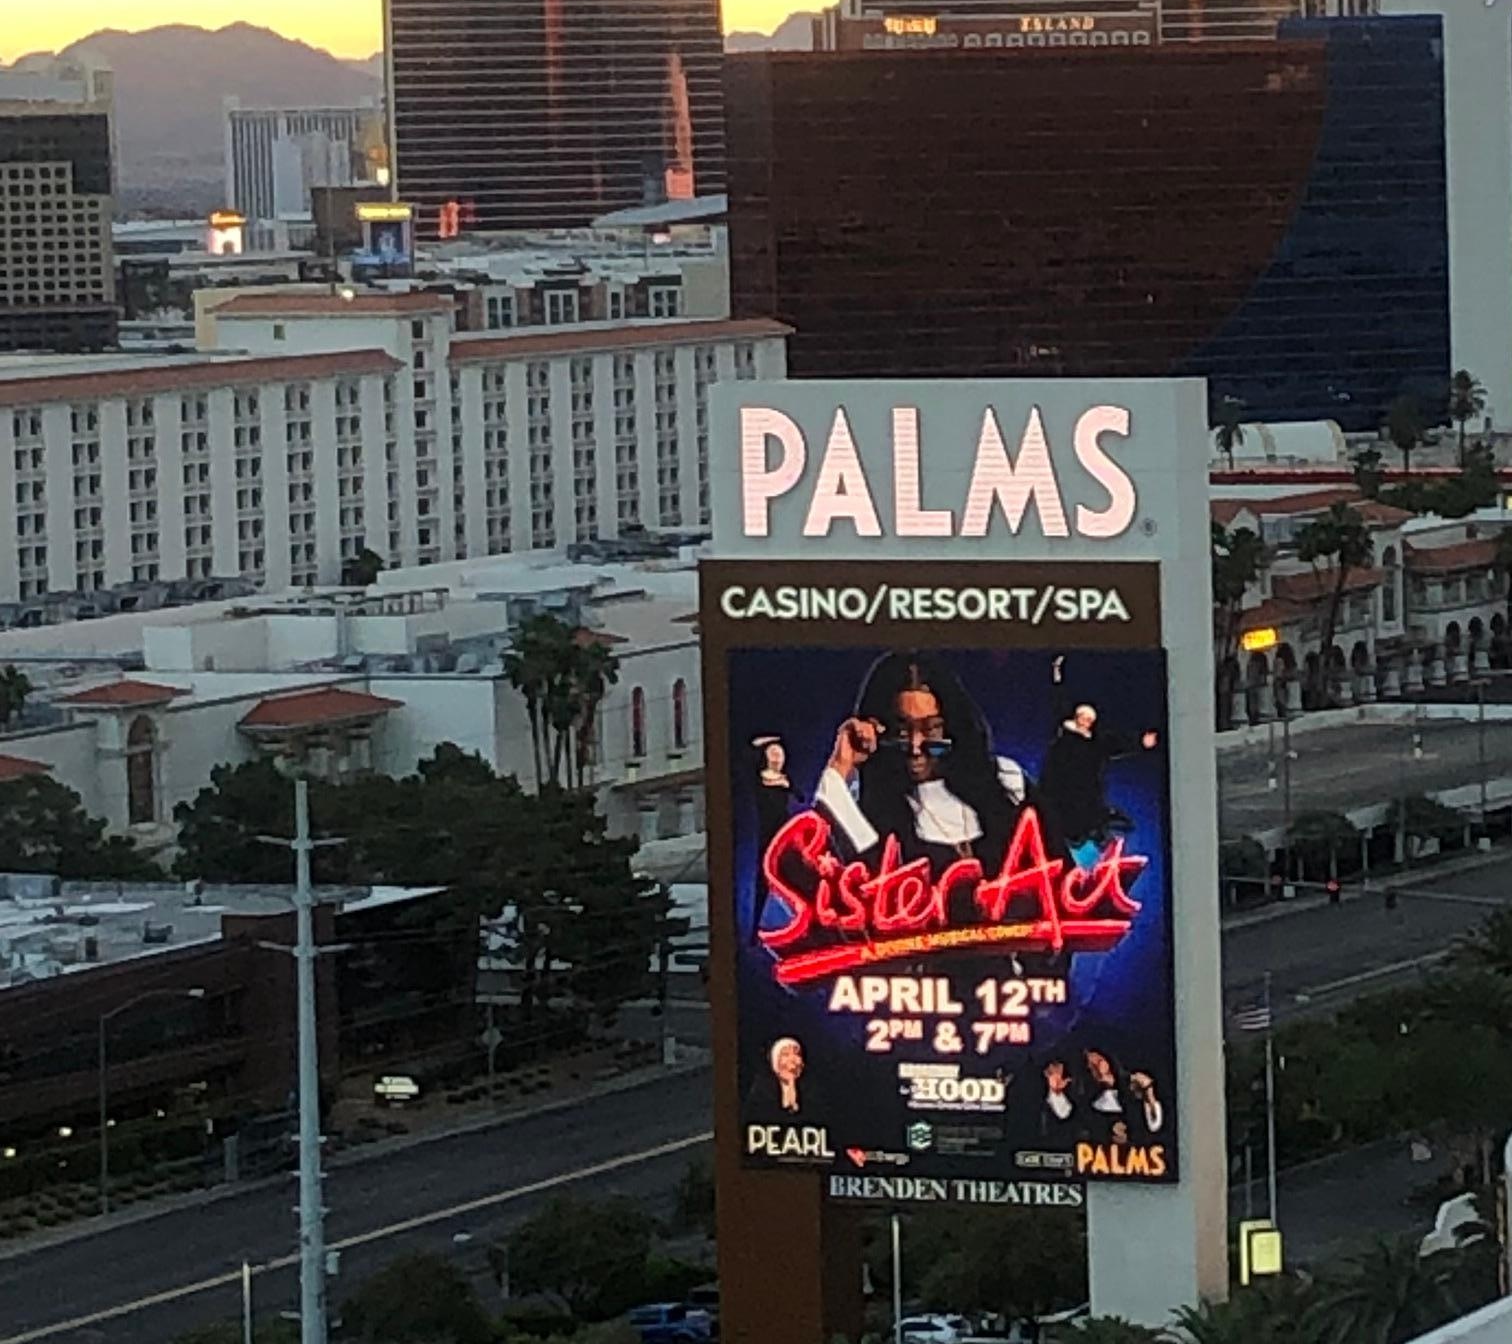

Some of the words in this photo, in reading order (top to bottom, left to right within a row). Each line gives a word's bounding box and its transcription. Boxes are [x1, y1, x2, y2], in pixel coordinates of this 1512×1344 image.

[740, 404, 1137, 538] PALMS
[720, 583, 1131, 624] CASINO/RESORT/SPA
[757, 809, 983, 940] Sister
[976, 805, 1148, 949] Act
[828, 975, 963, 1014] APRIL
[975, 978, 1066, 1017] 12TH
[865, 1018, 923, 1053] 2PM
[933, 1020, 964, 1053] &
[971, 1021, 1030, 1055] 7PM
[911, 1077, 1005, 1102] HOOD
[748, 1124, 836, 1157] PEARL
[1076, 1141, 1166, 1176] PALMS
[829, 1174, 947, 1201] BRENDEN
[951, 1178, 1083, 1207] THEATRES
